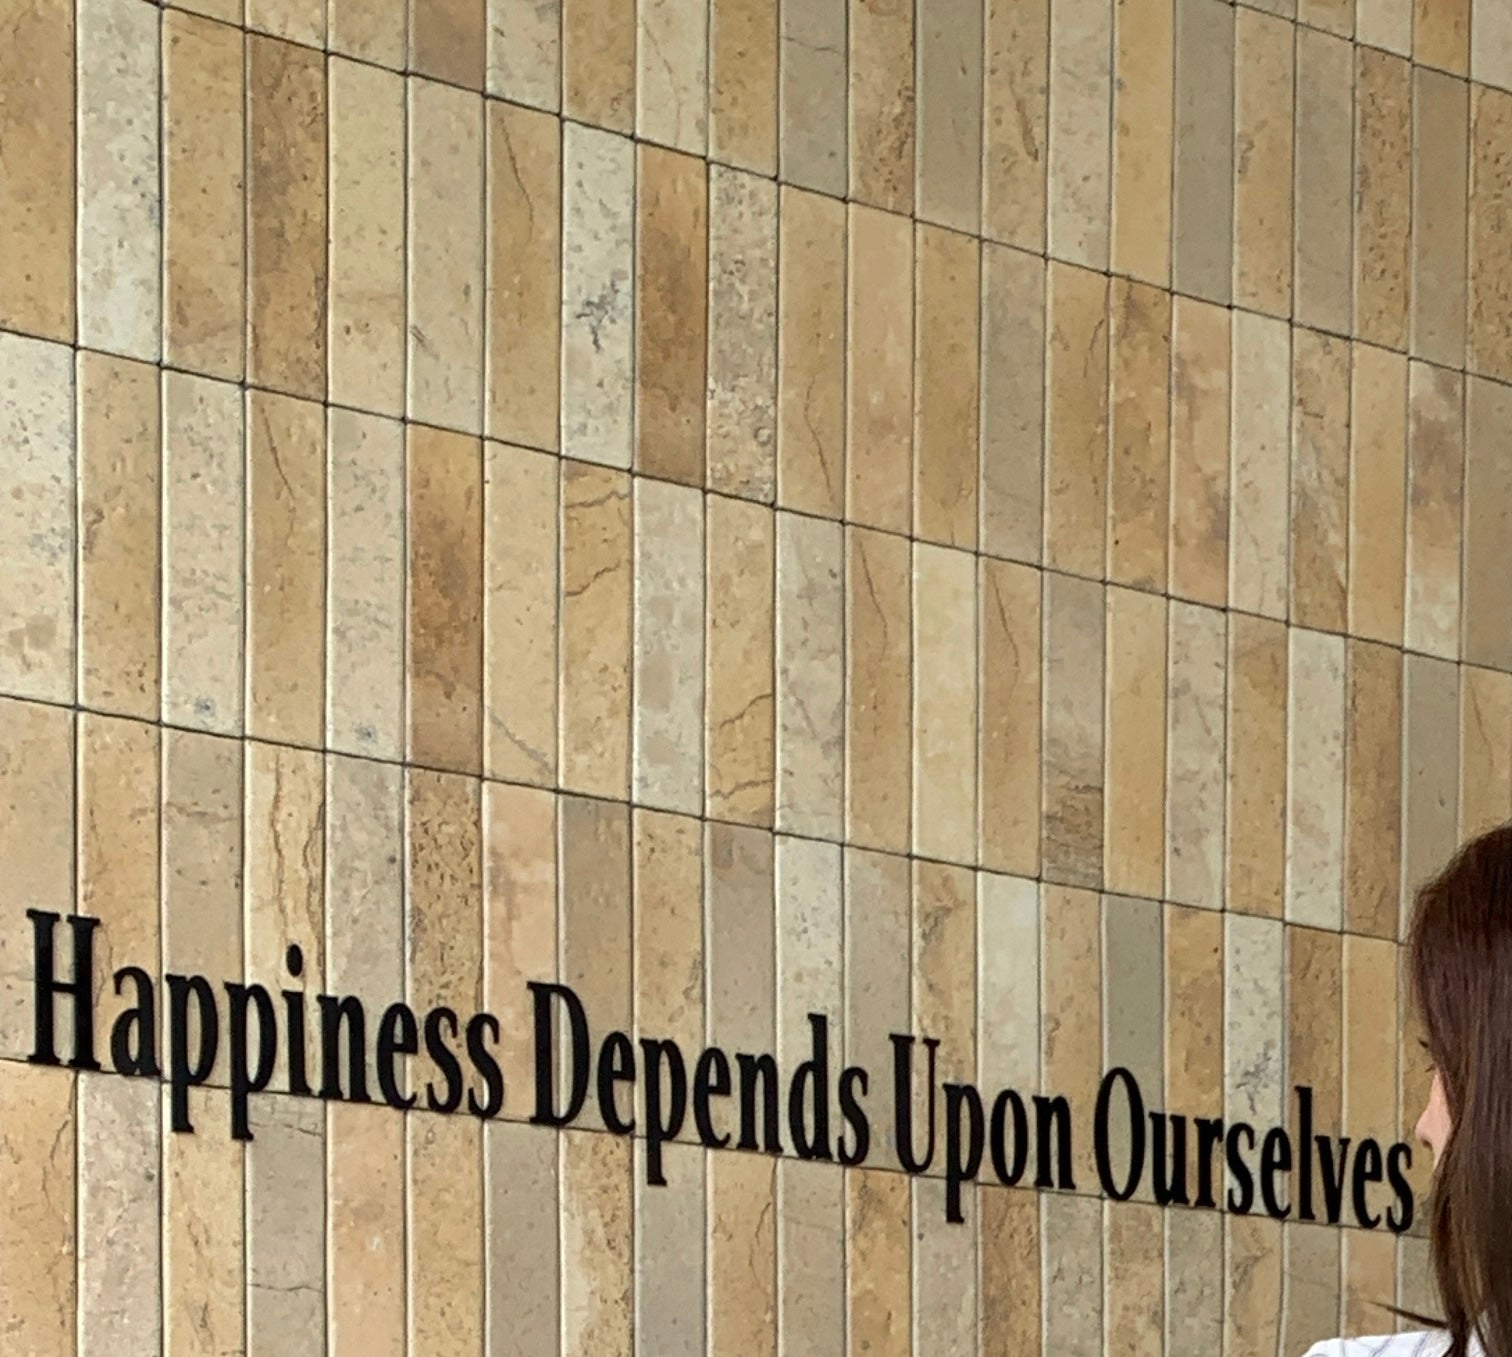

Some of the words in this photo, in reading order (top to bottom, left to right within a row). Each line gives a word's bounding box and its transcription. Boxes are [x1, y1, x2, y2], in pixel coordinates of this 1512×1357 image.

[25, 907, 504, 1143] Happiness
[525, 980, 871, 1187] Depends
[887, 1032, 1078, 1226] Upon
[1092, 1065, 1416, 1237] Ourselves
